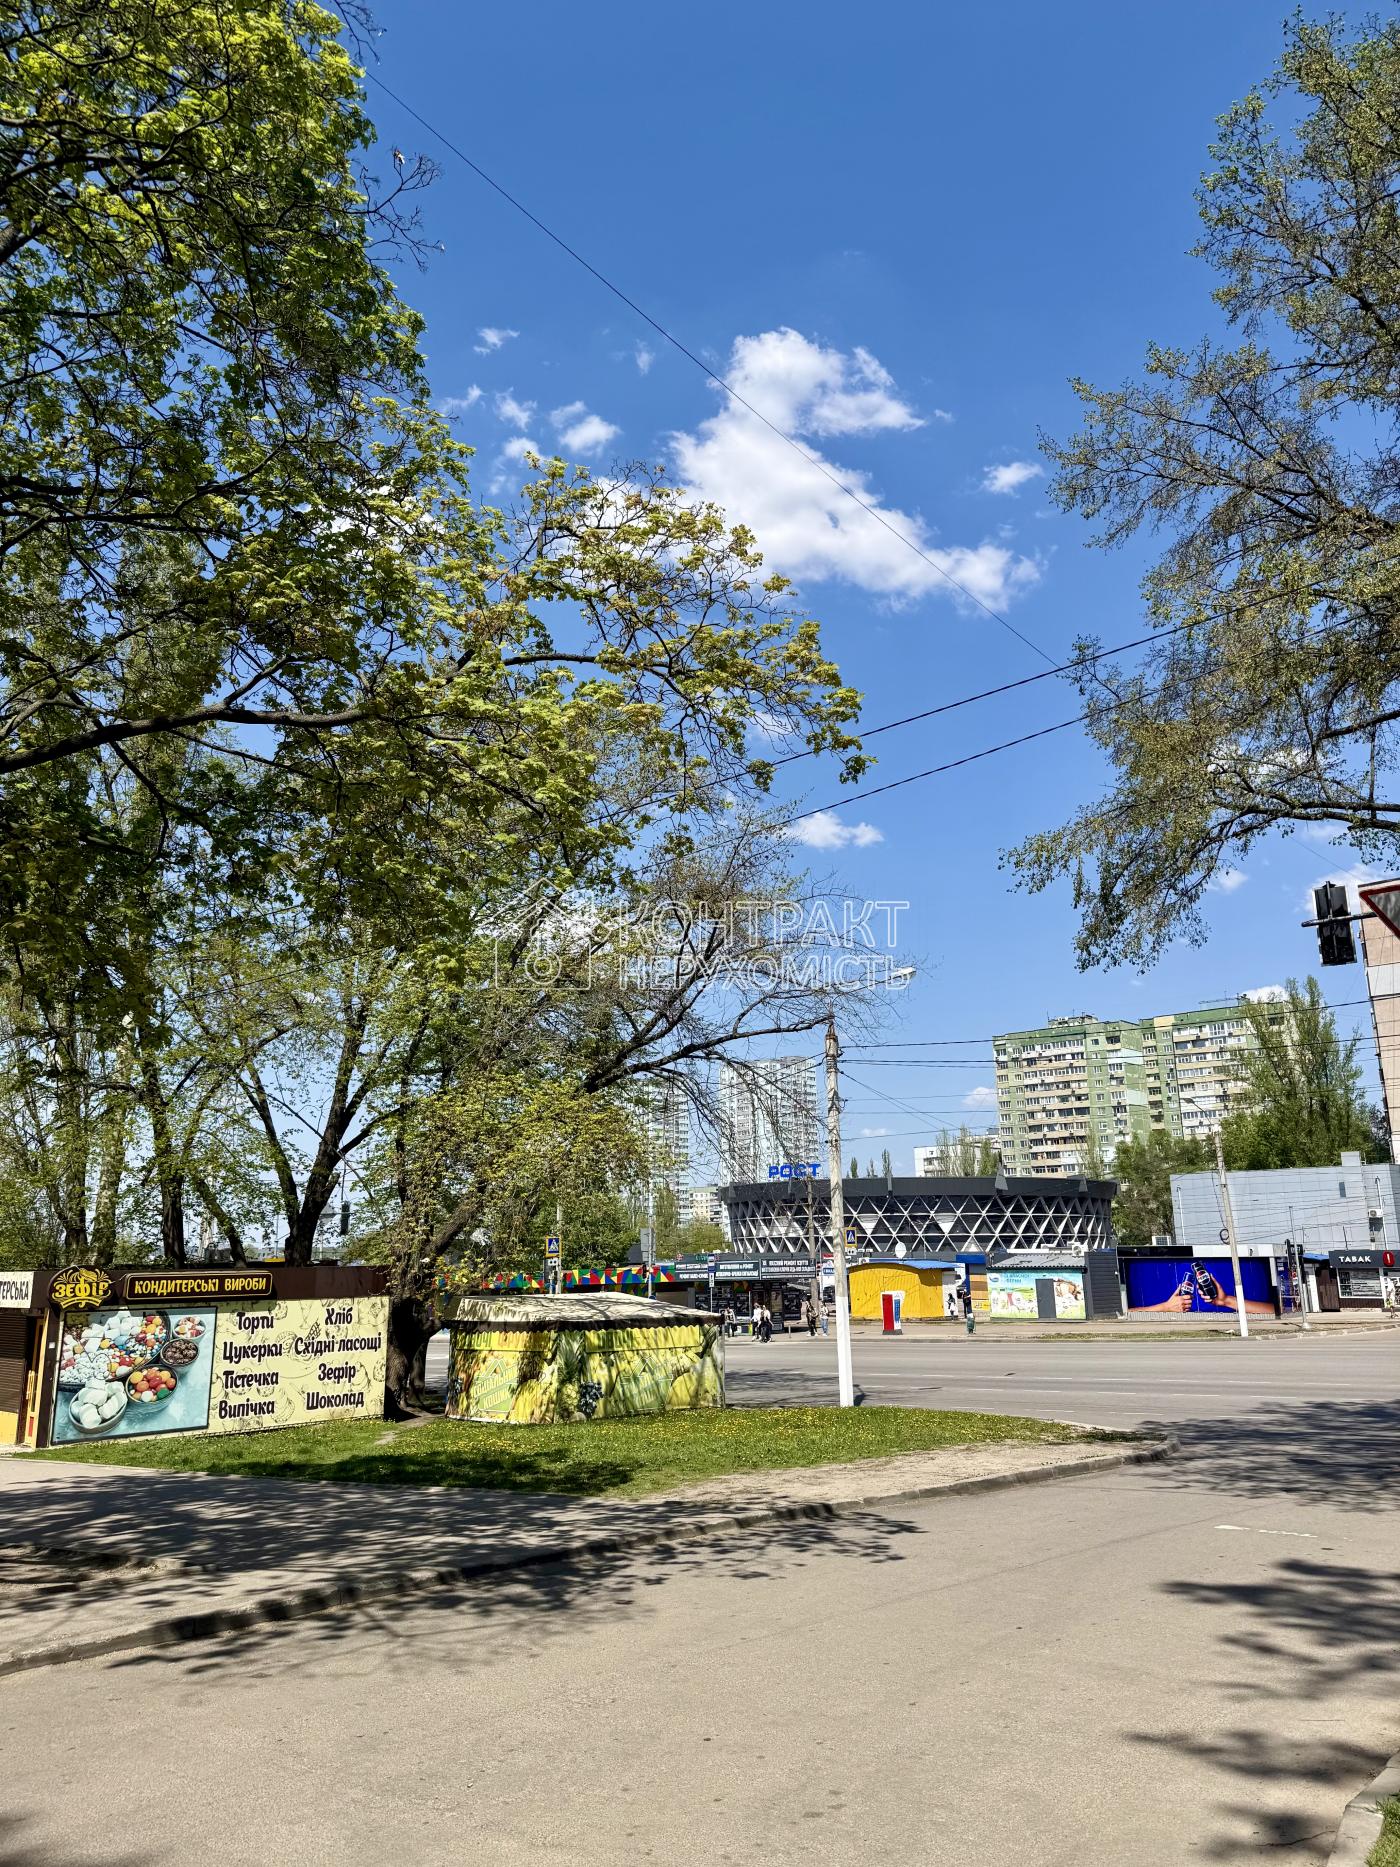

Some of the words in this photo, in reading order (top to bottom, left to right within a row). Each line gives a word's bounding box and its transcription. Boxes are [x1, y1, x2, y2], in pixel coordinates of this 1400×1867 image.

[54, 1280, 109, 1299] ЗЕФІР
[134, 1278, 219, 1296] КОНДИТЕРСЬКІ
[224, 1277, 267, 1292] ВИРОБИ
[236, 1311, 275, 1334] Торти
[325, 1307, 353, 1326] Хліб
[222, 1341, 283, 1364] Цукерки
[294, 1335, 335, 1357] Східні
[338, 1332, 382, 1353] ласощі
[222, 1370, 279, 1389] Тістечка
[318, 1361, 357, 1385] Зефір
[218, 1397, 275, 1419] Випічка
[306, 1391, 365, 1411] Шоколад
